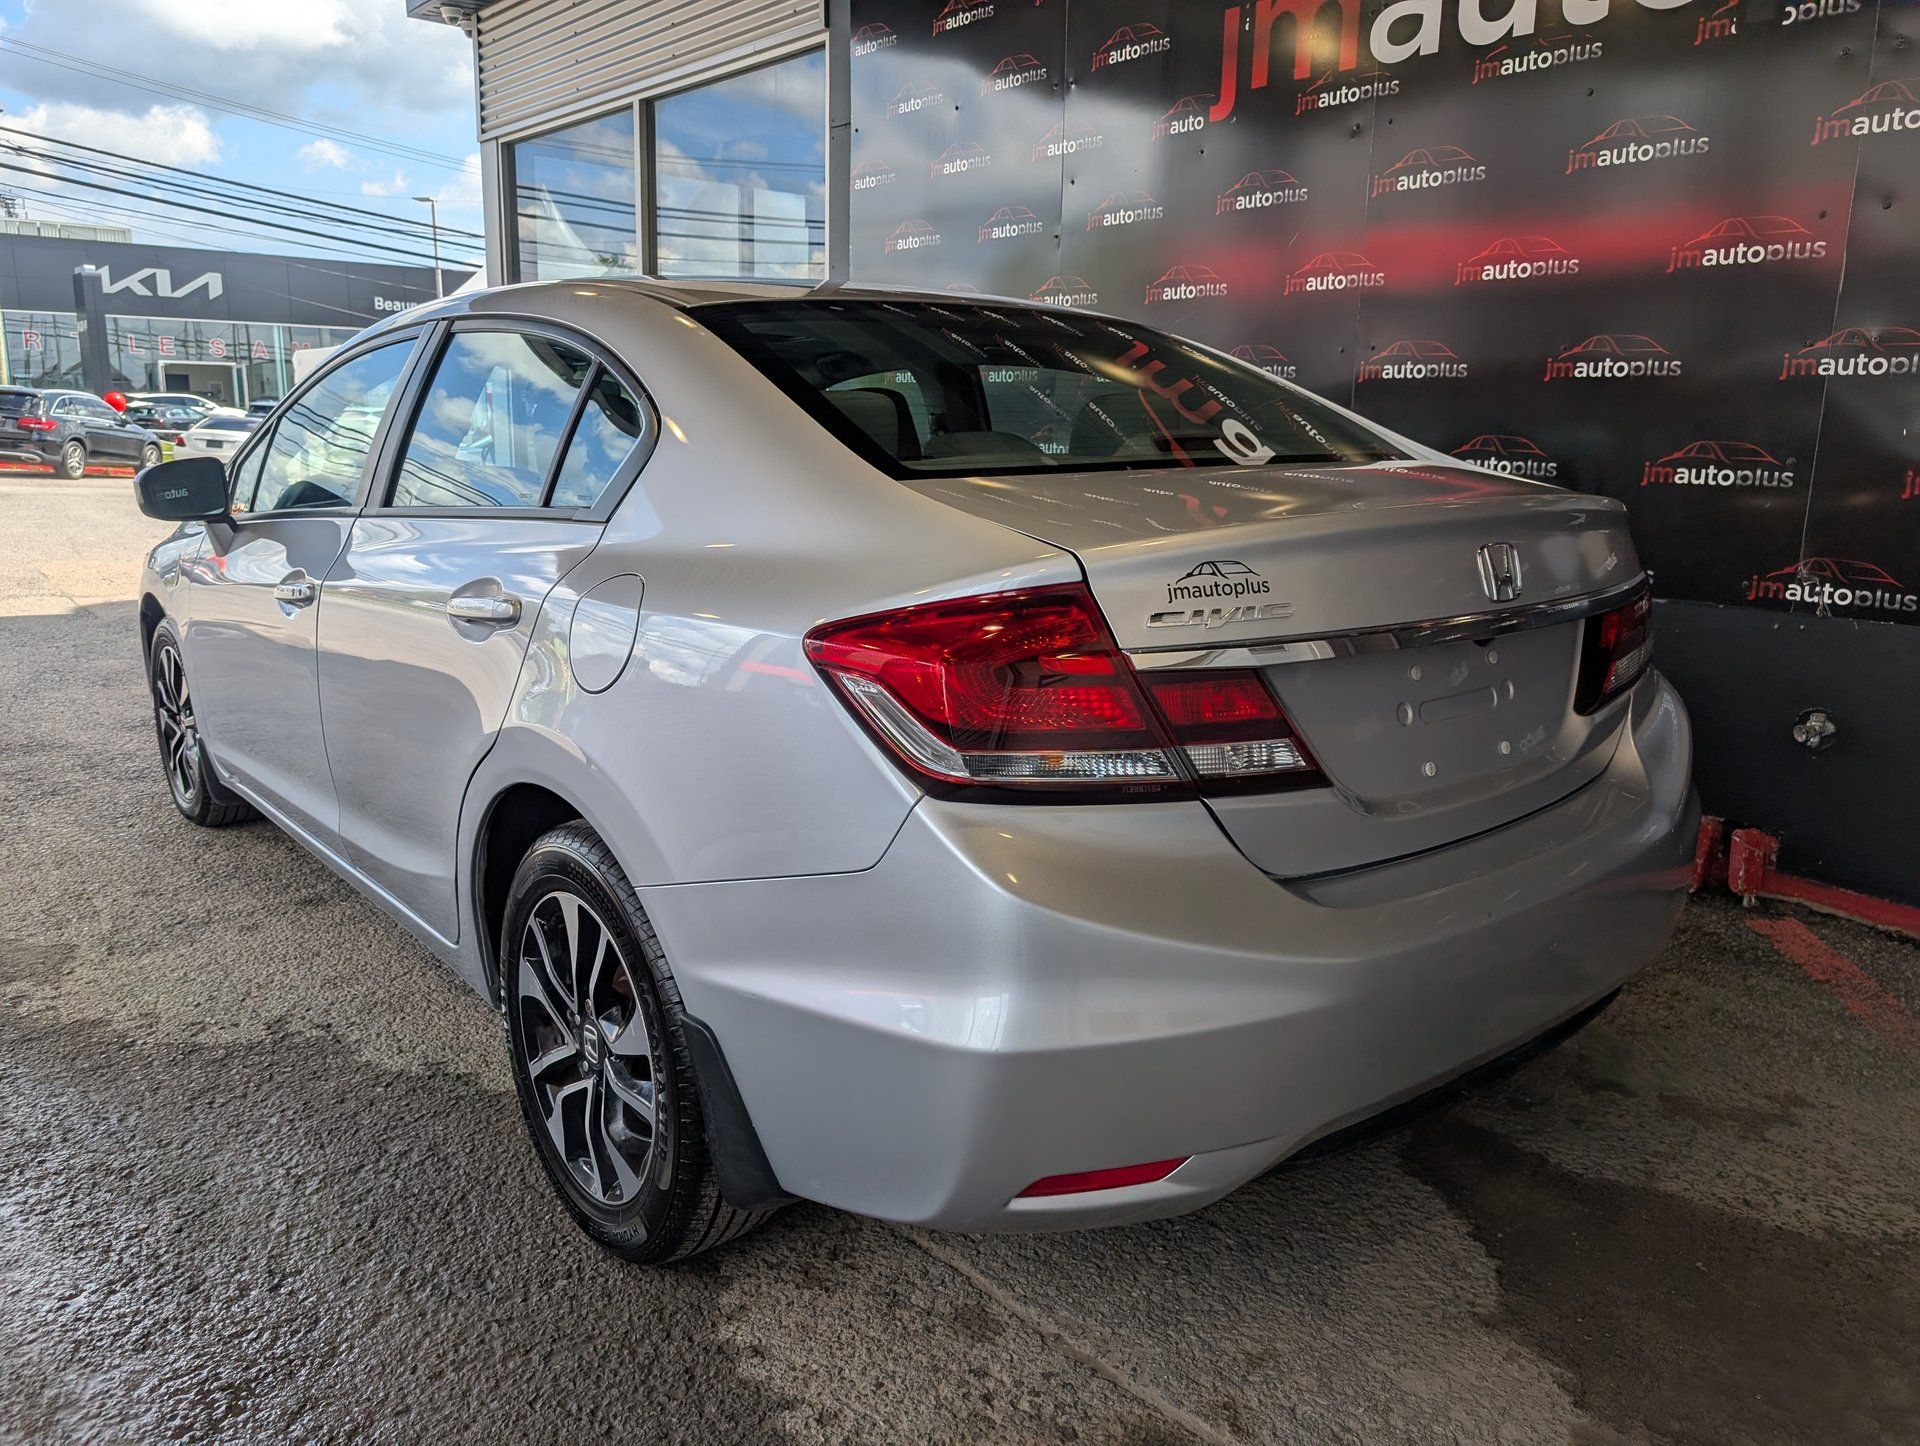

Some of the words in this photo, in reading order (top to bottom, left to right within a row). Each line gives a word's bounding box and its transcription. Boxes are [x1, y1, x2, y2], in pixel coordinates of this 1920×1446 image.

[932, 5, 994, 37] jmautoplus
[1091, 36, 1170, 72] jmautoplus
[1472, 41, 1603, 85] jmautoplus
[980, 68, 1047, 97] jmautoplus
[886, 93, 943, 119] jmautoplus
[1295, 79, 1400, 115] jmautoplus
[1811, 107, 1920, 146] jmauto
[1031, 134, 1103, 161] jmautoplus
[1565, 135, 1709, 174] jmautoplus
[929, 155, 991, 180] jmautoplus
[1372, 165, 1486, 198] jmautoplus
[1216, 187, 1308, 215] jmautoplus
[978, 220, 1043, 243] jmautoplus
[1087, 205, 1163, 231] jmautoplus
[885, 233, 941, 254] jmautoplus
[1667, 240, 1826, 273] jmautoplus
[96, 264, 223, 300] KIA
[1284, 272, 1384, 296] jmautoplus
[1455, 257, 1579, 286] jmautoplus
[1144, 281, 1227, 304] jmautoplus
[1358, 360, 1468, 384] jmautoplus
[1544, 356, 1682, 382] jmautoplus
[1779, 352, 1920, 382] jmautopl
[1641, 462, 1795, 489] jmautoplus
[1167, 577, 1270, 604] jmautoplus
[1748, 575, 1919, 611] jmautoplus
[1146, 602, 1294, 629] CIVIC
